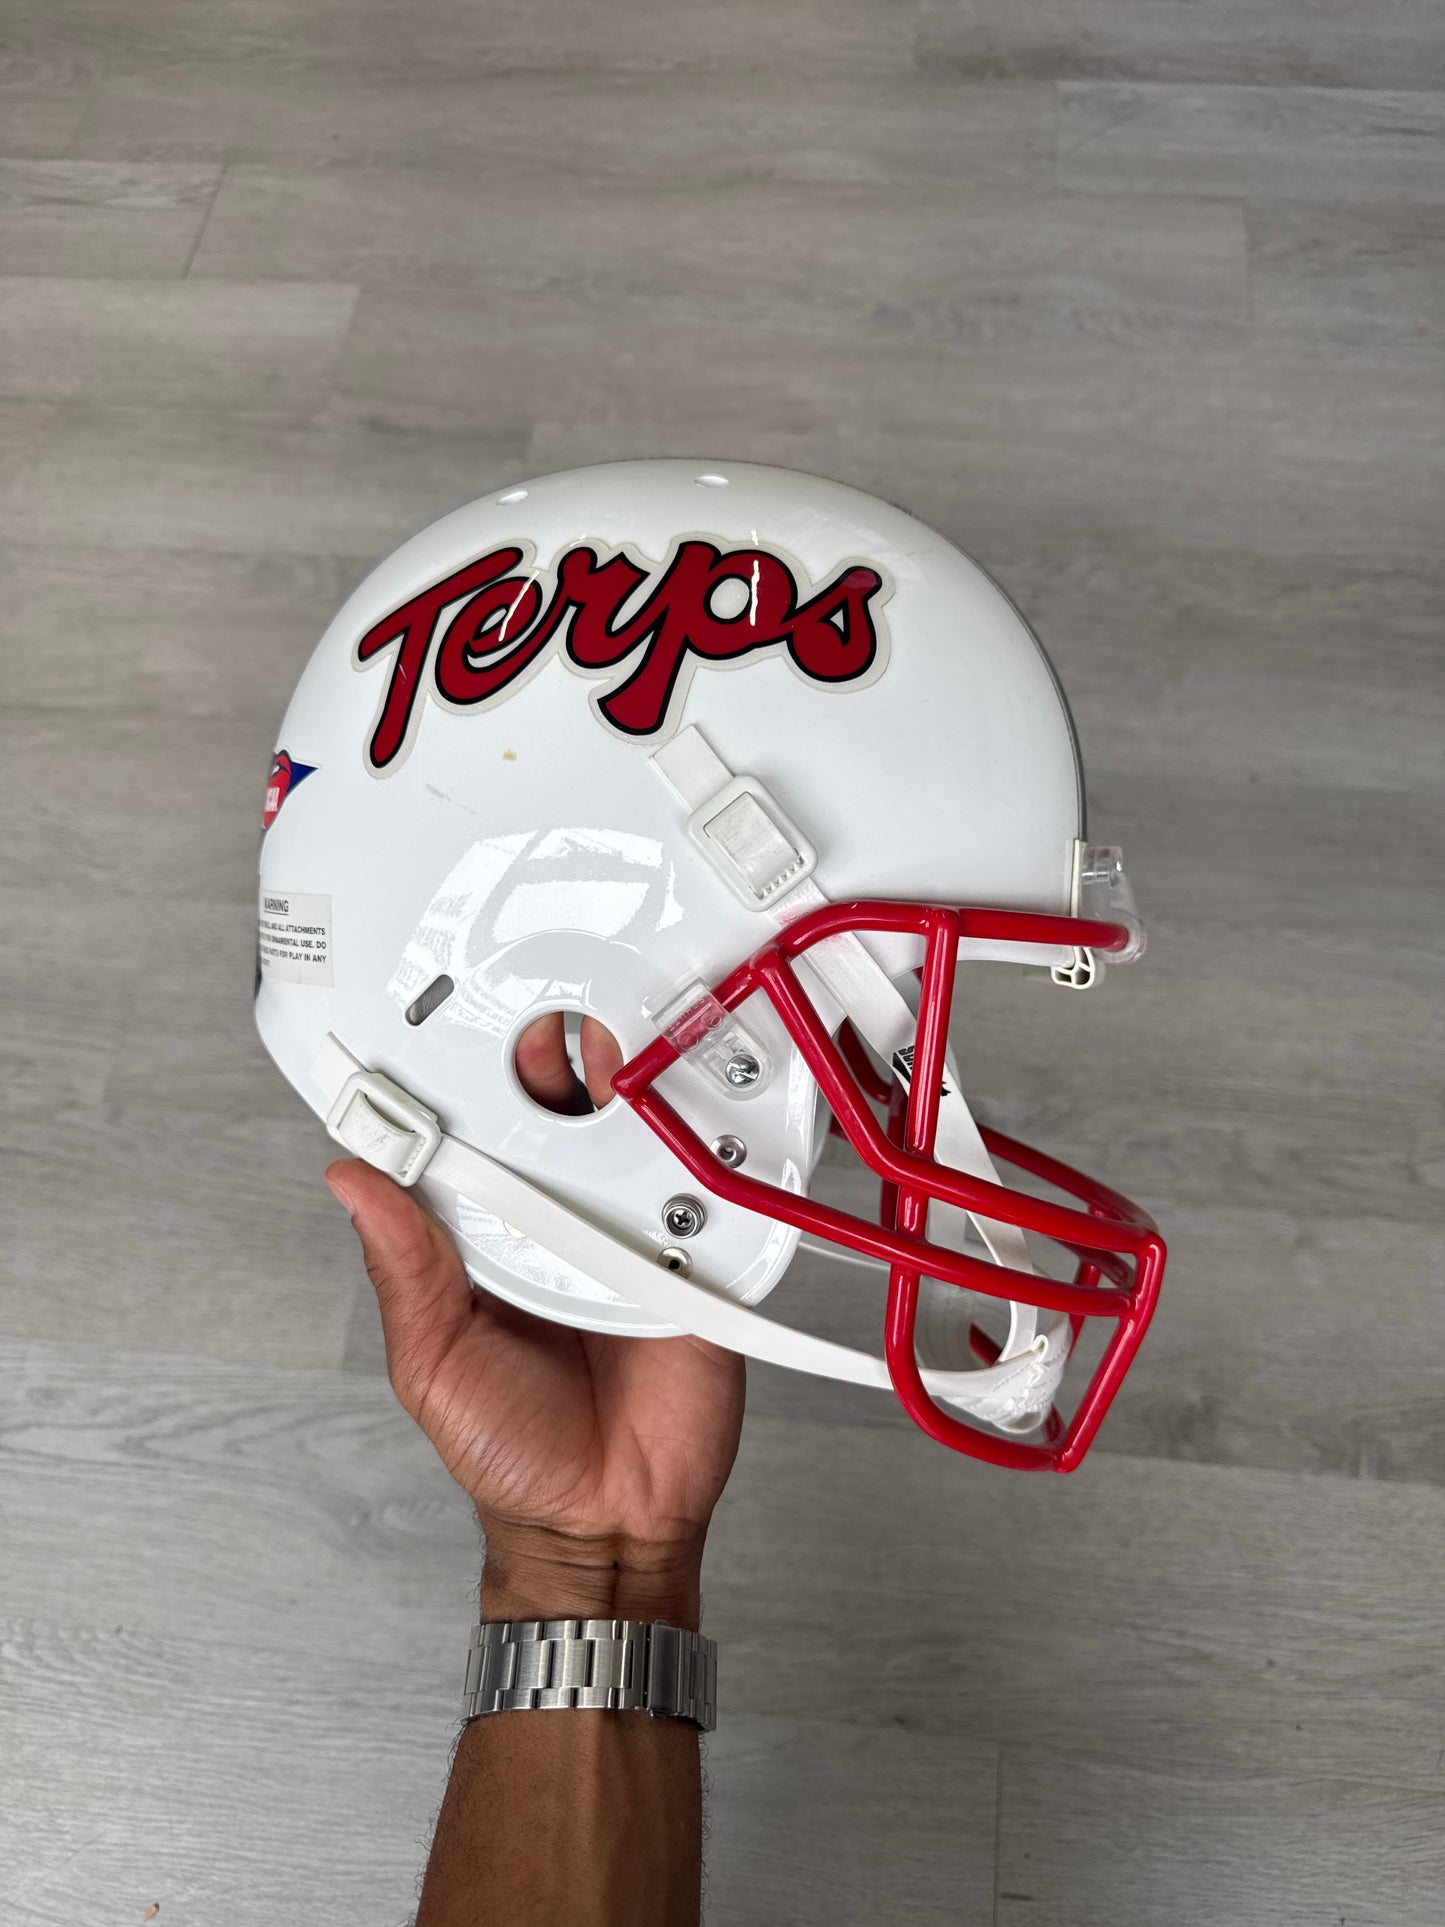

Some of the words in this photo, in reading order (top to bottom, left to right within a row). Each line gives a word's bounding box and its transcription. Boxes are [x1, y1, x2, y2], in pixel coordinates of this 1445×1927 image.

[357, 539, 884, 769] Terps
[285, 925, 326, 936] ATTACHMENTS
[316, 941, 327, 949] DO
[288, 951, 303, 961] PLAY
[312, 955, 327, 963] ANY
